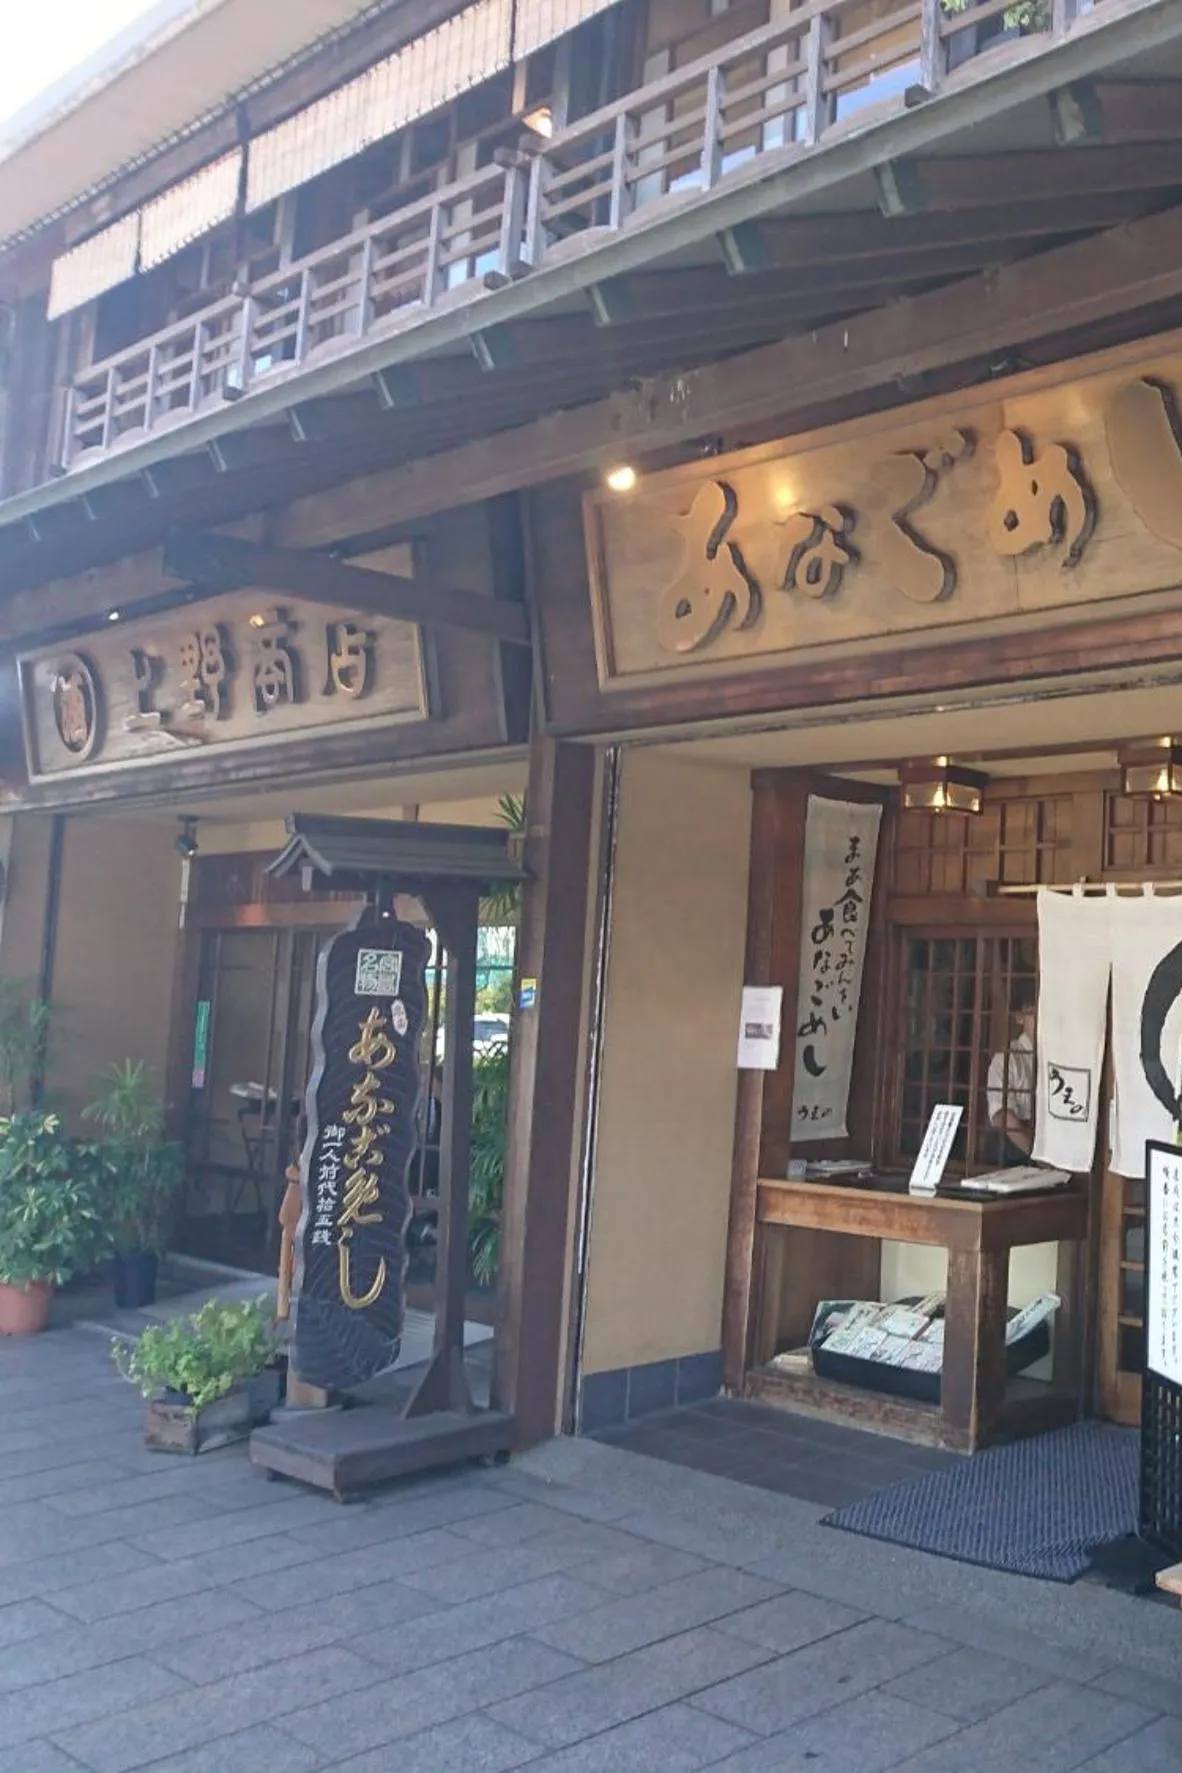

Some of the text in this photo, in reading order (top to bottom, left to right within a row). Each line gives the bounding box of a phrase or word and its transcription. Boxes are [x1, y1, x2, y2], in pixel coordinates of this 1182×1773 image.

[798, 908, 834, 1077] あなごめし
